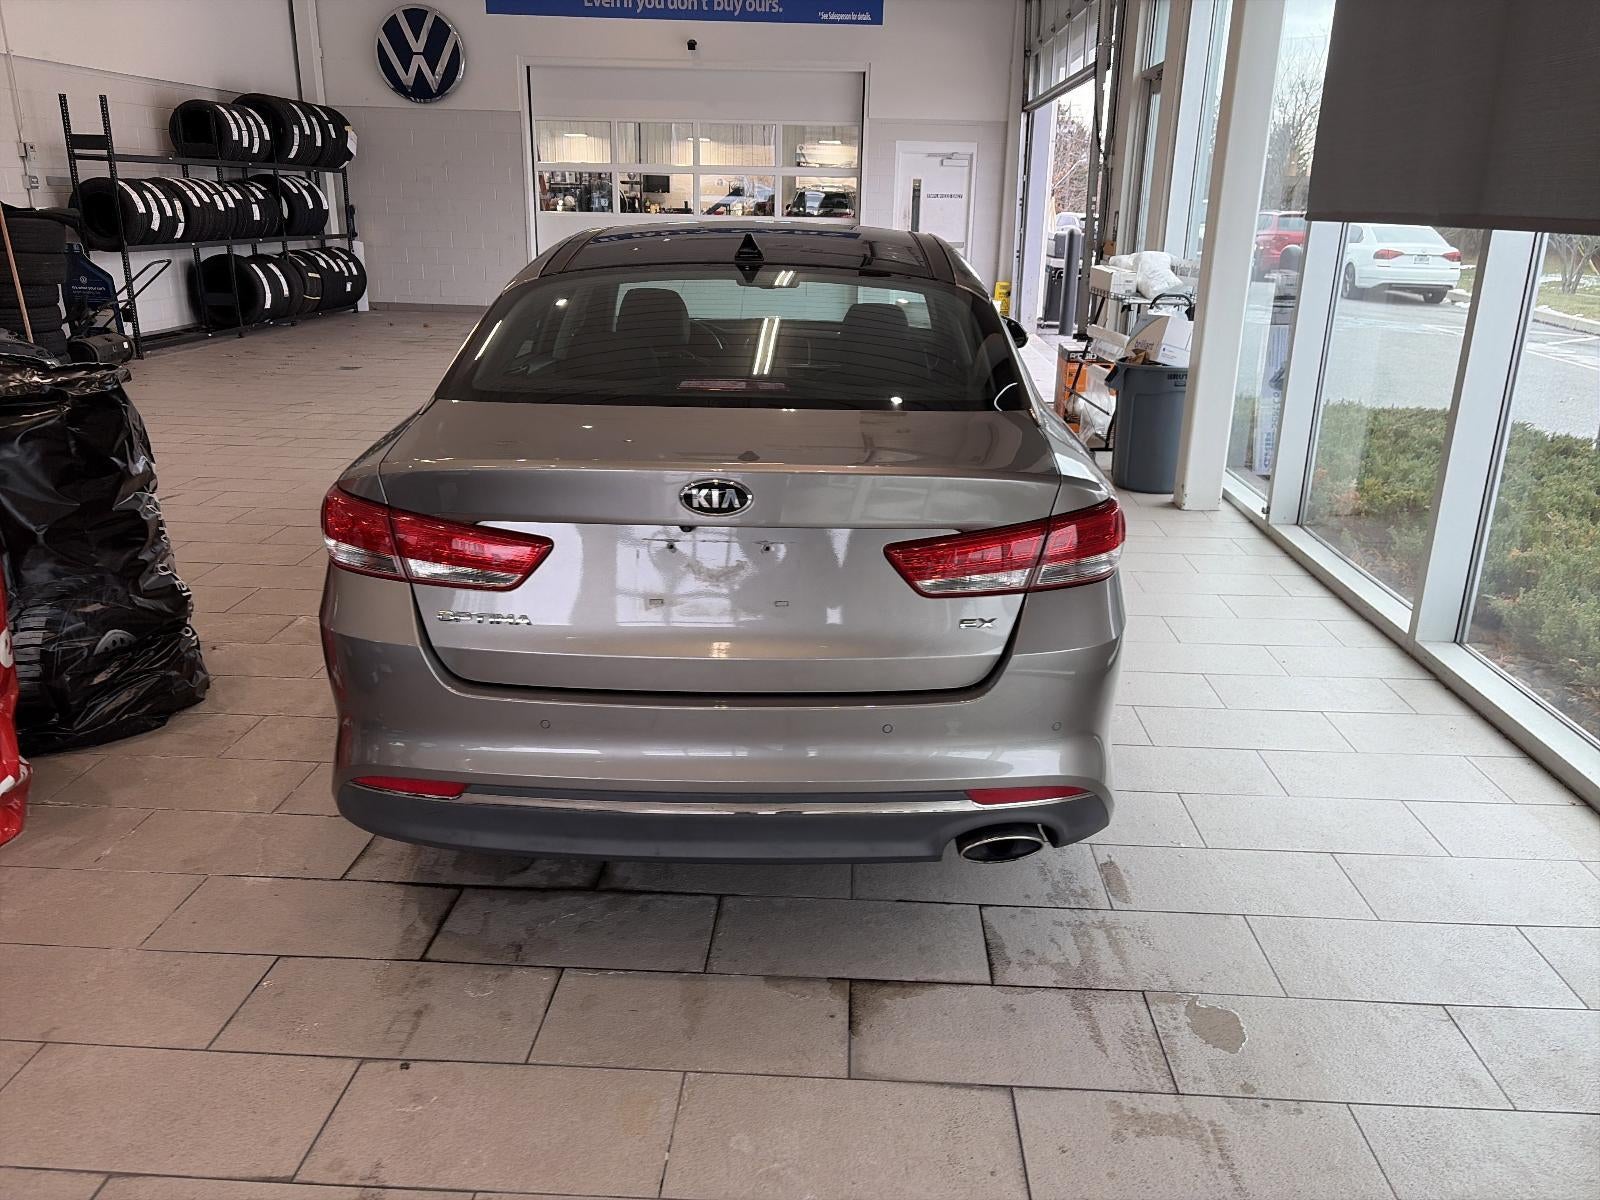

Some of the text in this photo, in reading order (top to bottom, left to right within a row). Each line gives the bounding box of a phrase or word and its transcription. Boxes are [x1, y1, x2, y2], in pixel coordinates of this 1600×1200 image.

[635, 0, 665, 14] you
[668, 0, 708, 11] dont
[713, 0, 743, 16] buy
[745, 0, 784, 12] ours.
[376, 6, 461, 95] VW
[691, 488, 741, 508] KIA
[437, 609, 532, 626] OPTIMA
[959, 617, 998, 629] EX
